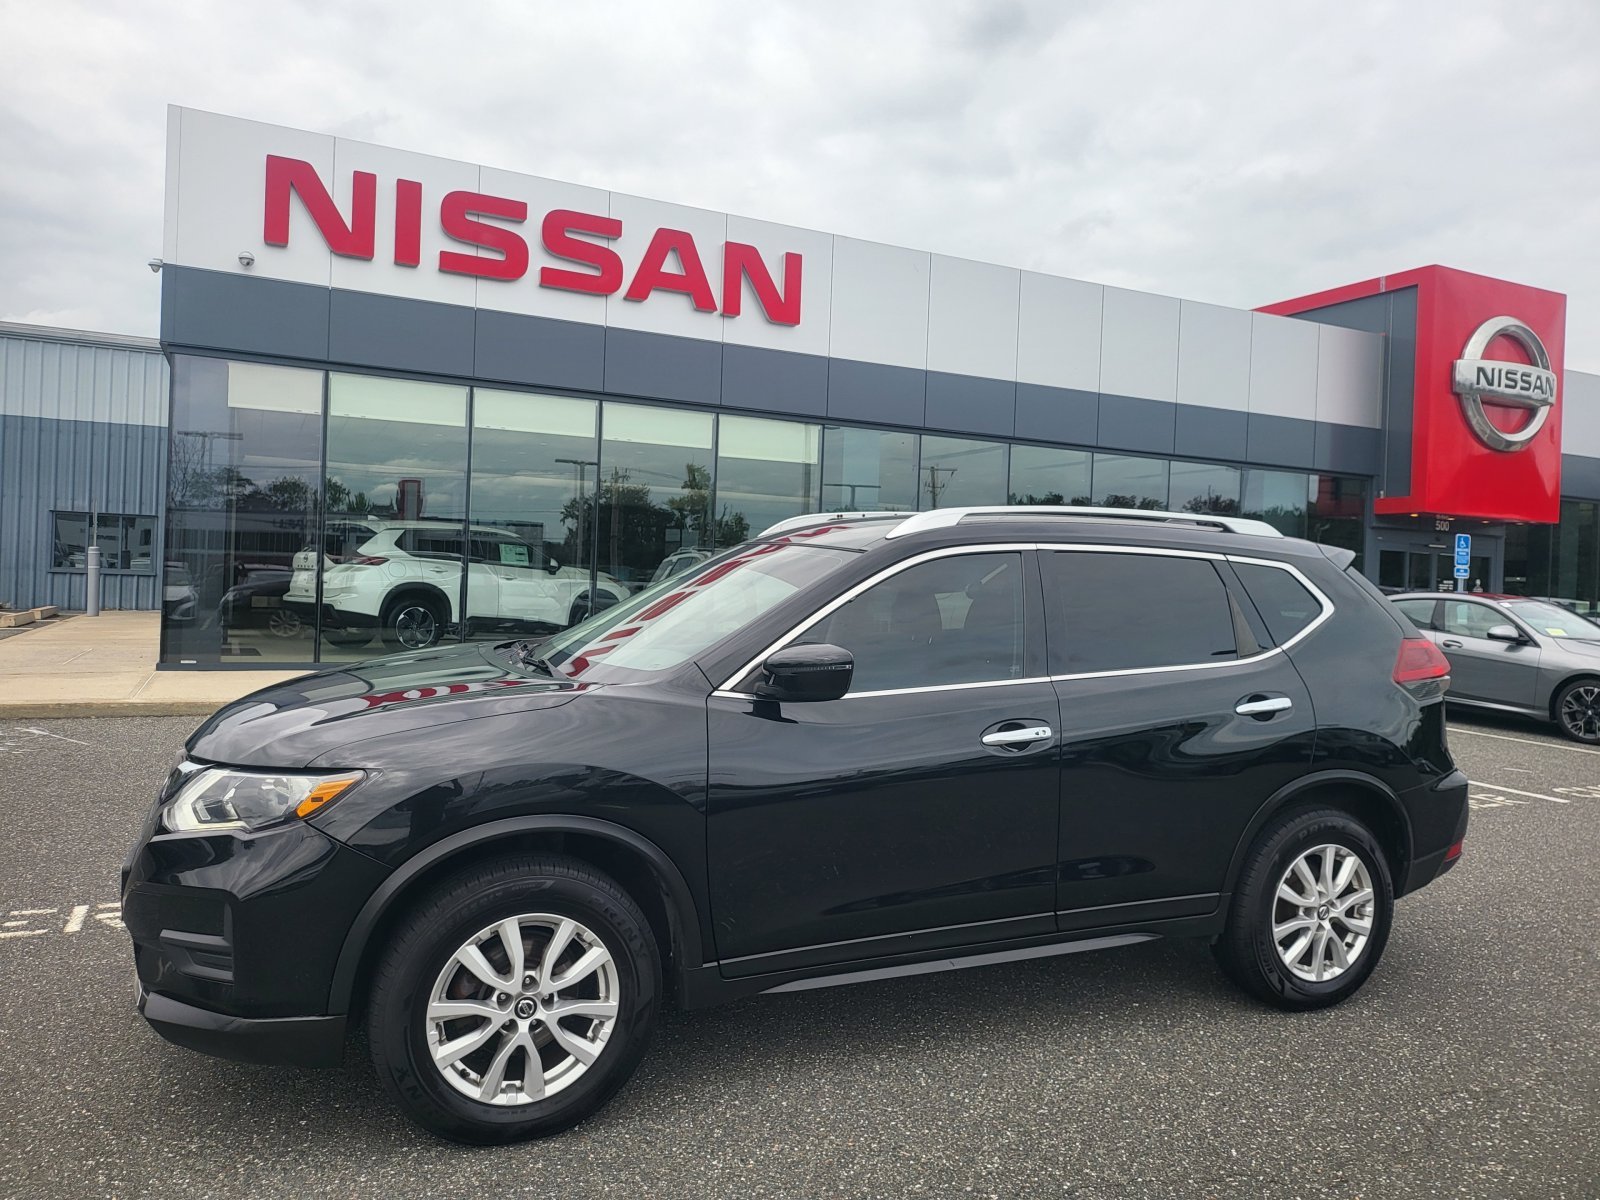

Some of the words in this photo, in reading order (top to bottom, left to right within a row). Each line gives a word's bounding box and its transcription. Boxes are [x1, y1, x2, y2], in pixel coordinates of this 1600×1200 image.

[264, 154, 803, 327] NISSAN
[1476, 366, 1555, 398] NISSAN
[1435, 520, 1450, 531] 500
